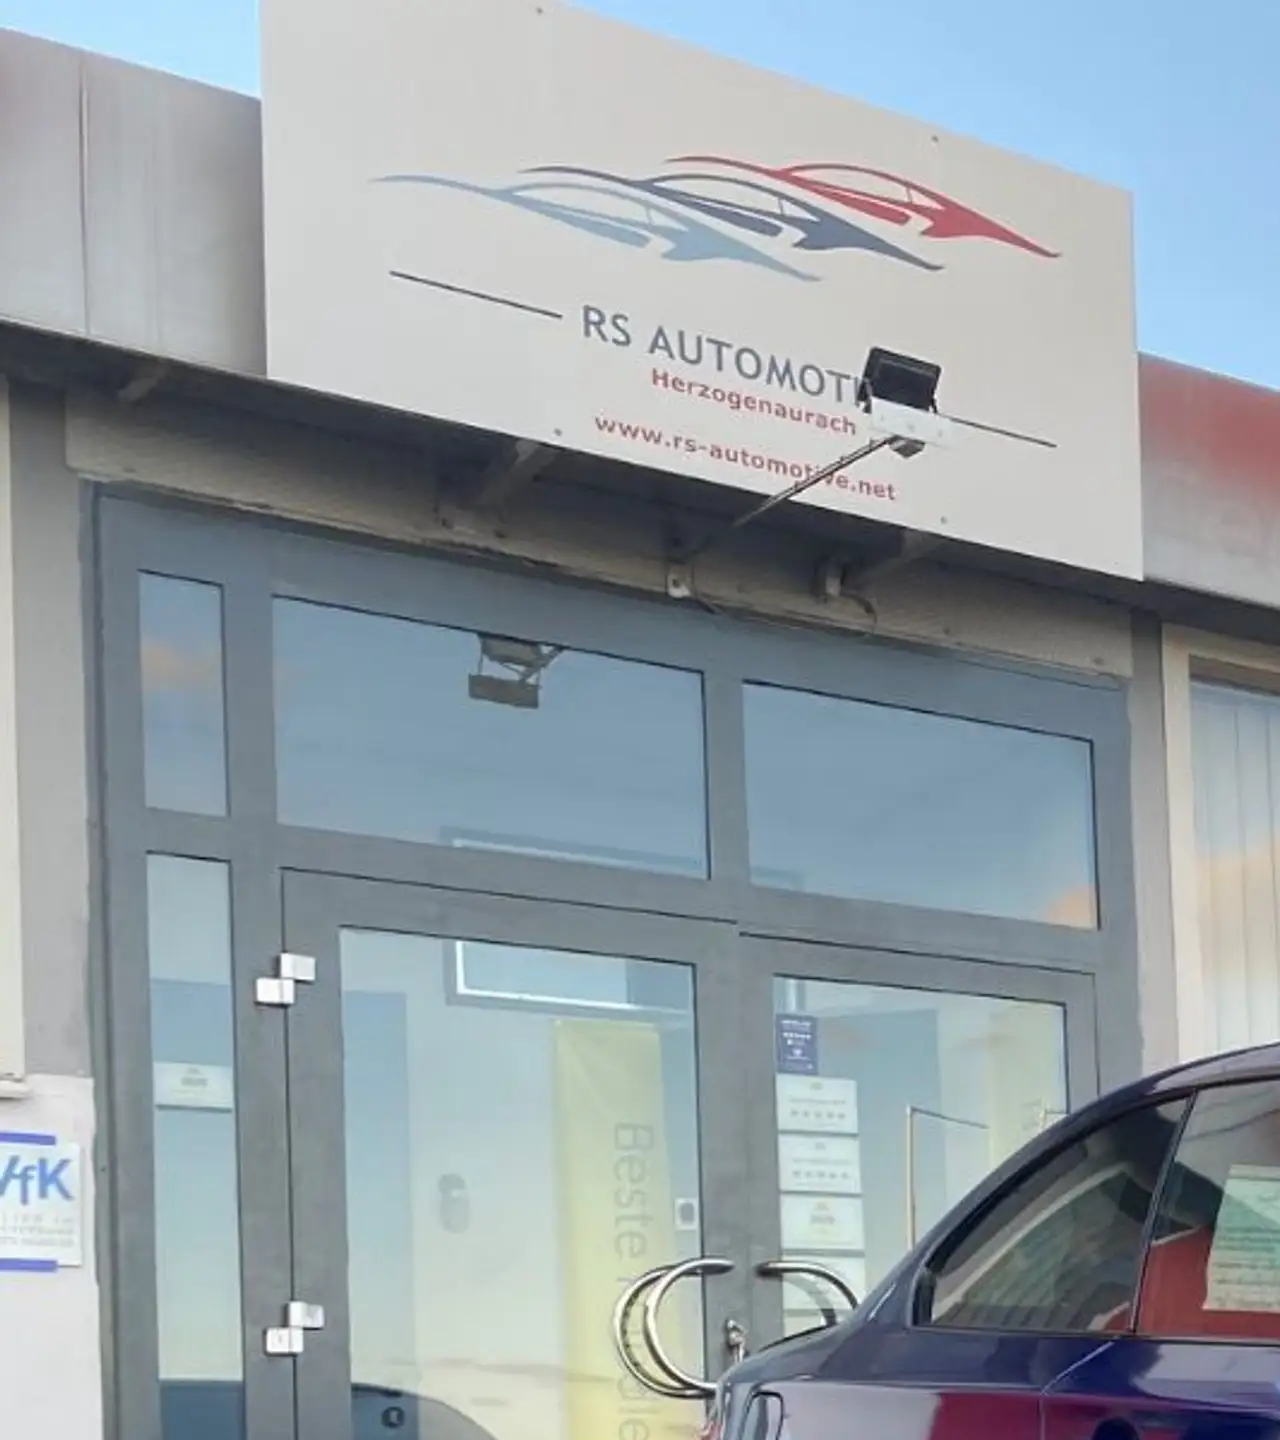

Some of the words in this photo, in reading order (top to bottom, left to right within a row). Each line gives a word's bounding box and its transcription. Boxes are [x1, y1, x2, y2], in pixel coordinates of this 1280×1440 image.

[582, 304, 631, 346] RS
[649, 325, 862, 407] AUTOMOTI
[652, 367, 857, 436] Herzogenaurach
[613, 1122, 655, 1260] Beste
